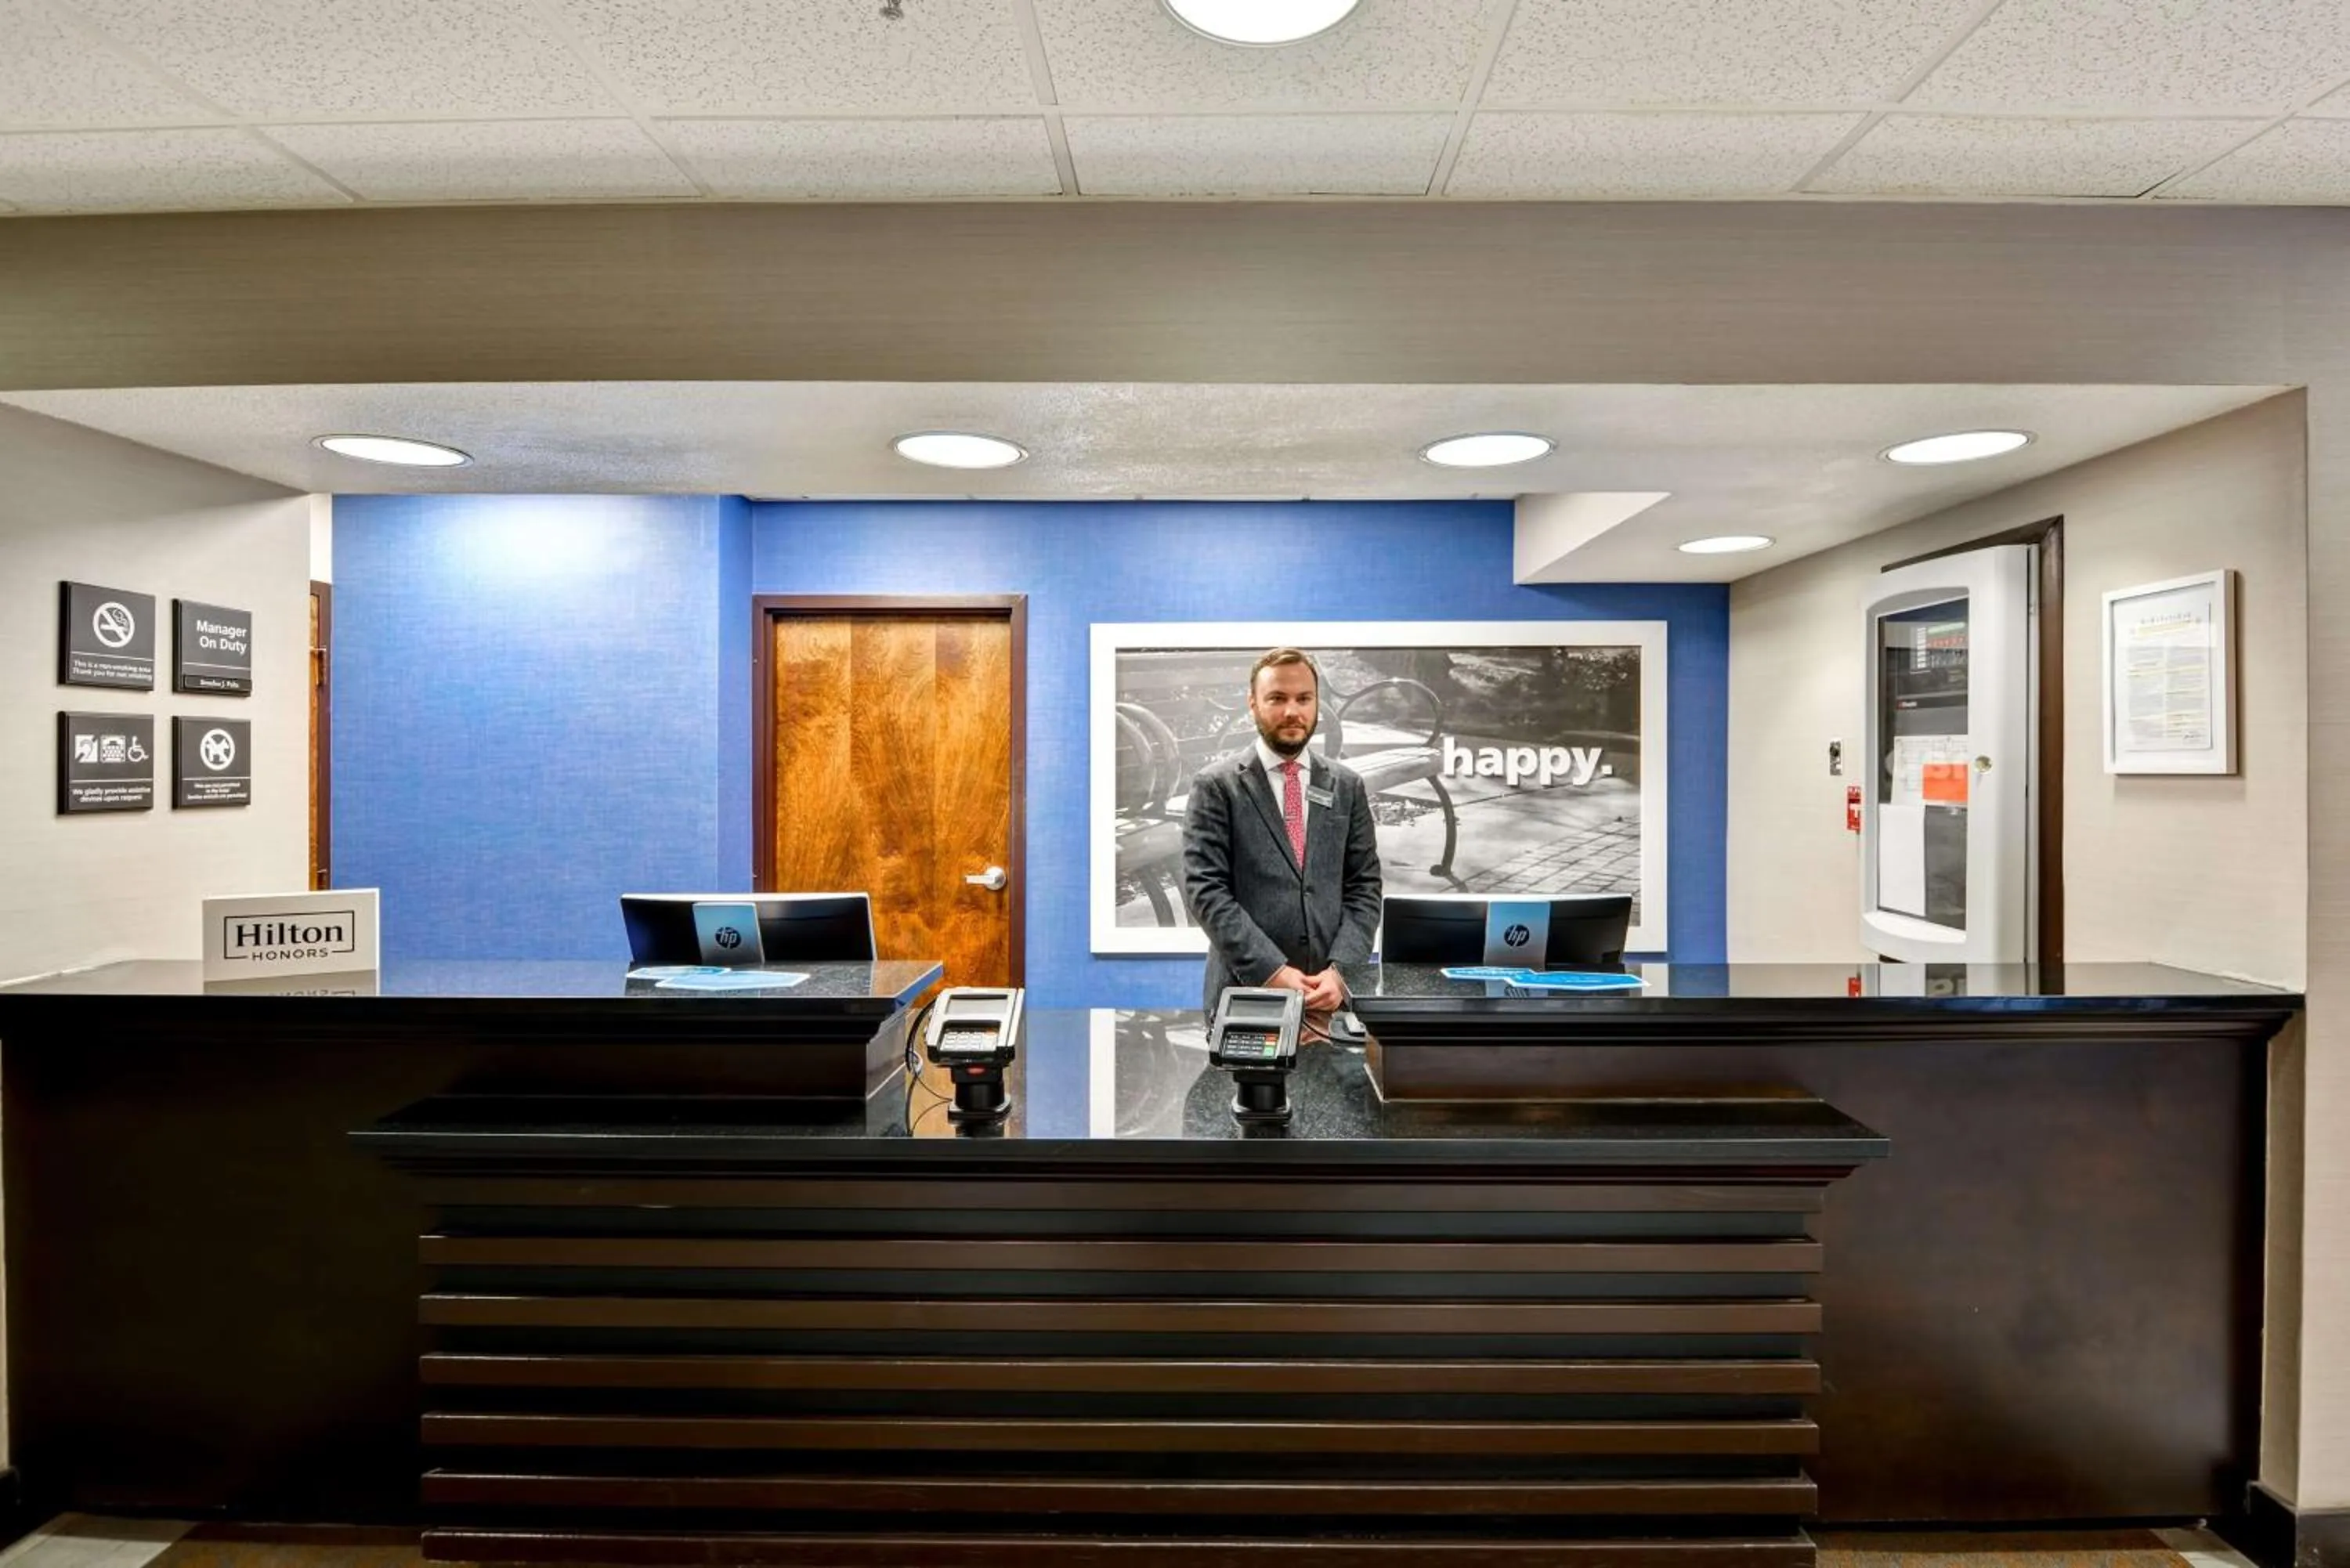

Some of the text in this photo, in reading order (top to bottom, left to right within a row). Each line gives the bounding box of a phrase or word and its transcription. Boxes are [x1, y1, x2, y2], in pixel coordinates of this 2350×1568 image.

[196, 620, 248, 638] Manager
[199, 635, 247, 655] On Duty
[1443, 736, 1613, 786] happy.
[236, 923, 344, 948] Hilton
[718, 927, 738, 948] hp
[1507, 925, 1528, 947] hp
[251, 947, 329, 961] HONORS
